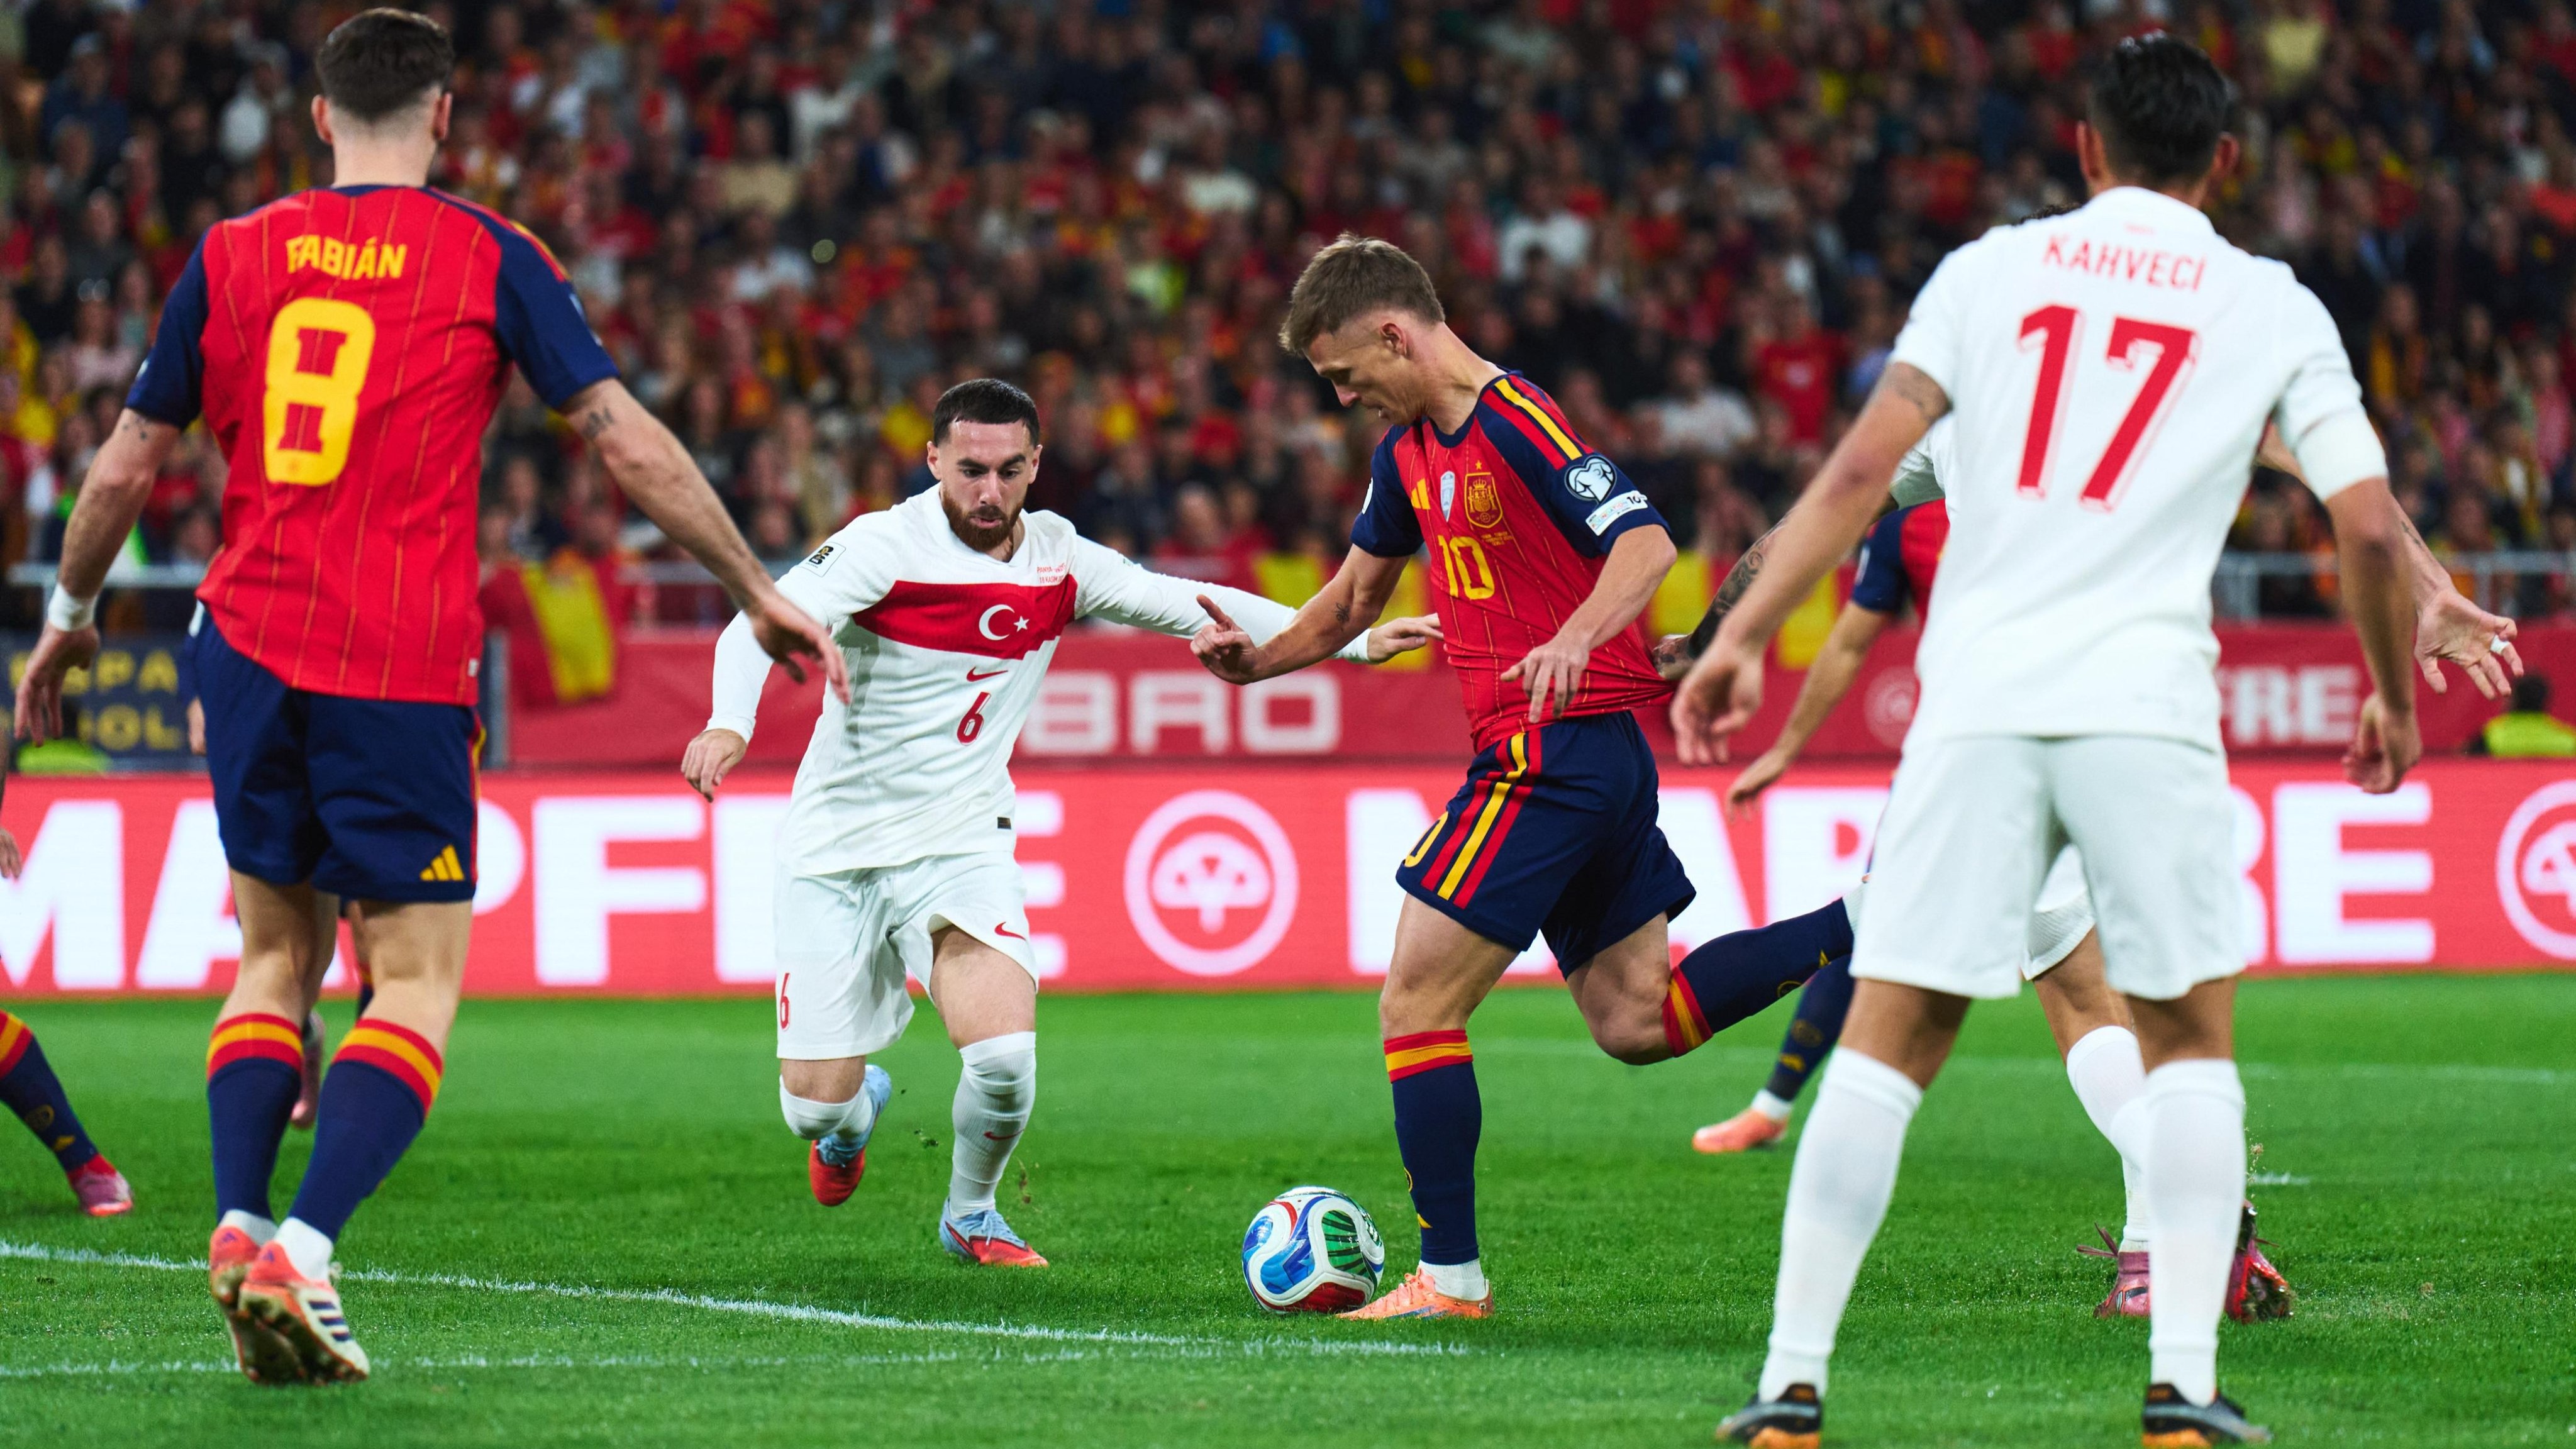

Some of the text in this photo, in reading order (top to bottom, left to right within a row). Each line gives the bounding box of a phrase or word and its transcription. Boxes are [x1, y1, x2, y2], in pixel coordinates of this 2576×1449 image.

[286, 234, 408, 280] FABIÁN
[264, 296, 375, 487] 8
[2016, 304, 2202, 514] 17
[1438, 534, 1495, 601] 10
[956, 691, 992, 747] 6
[2214, 663, 2360, 743] RE
[779, 972, 791, 1032] 6
